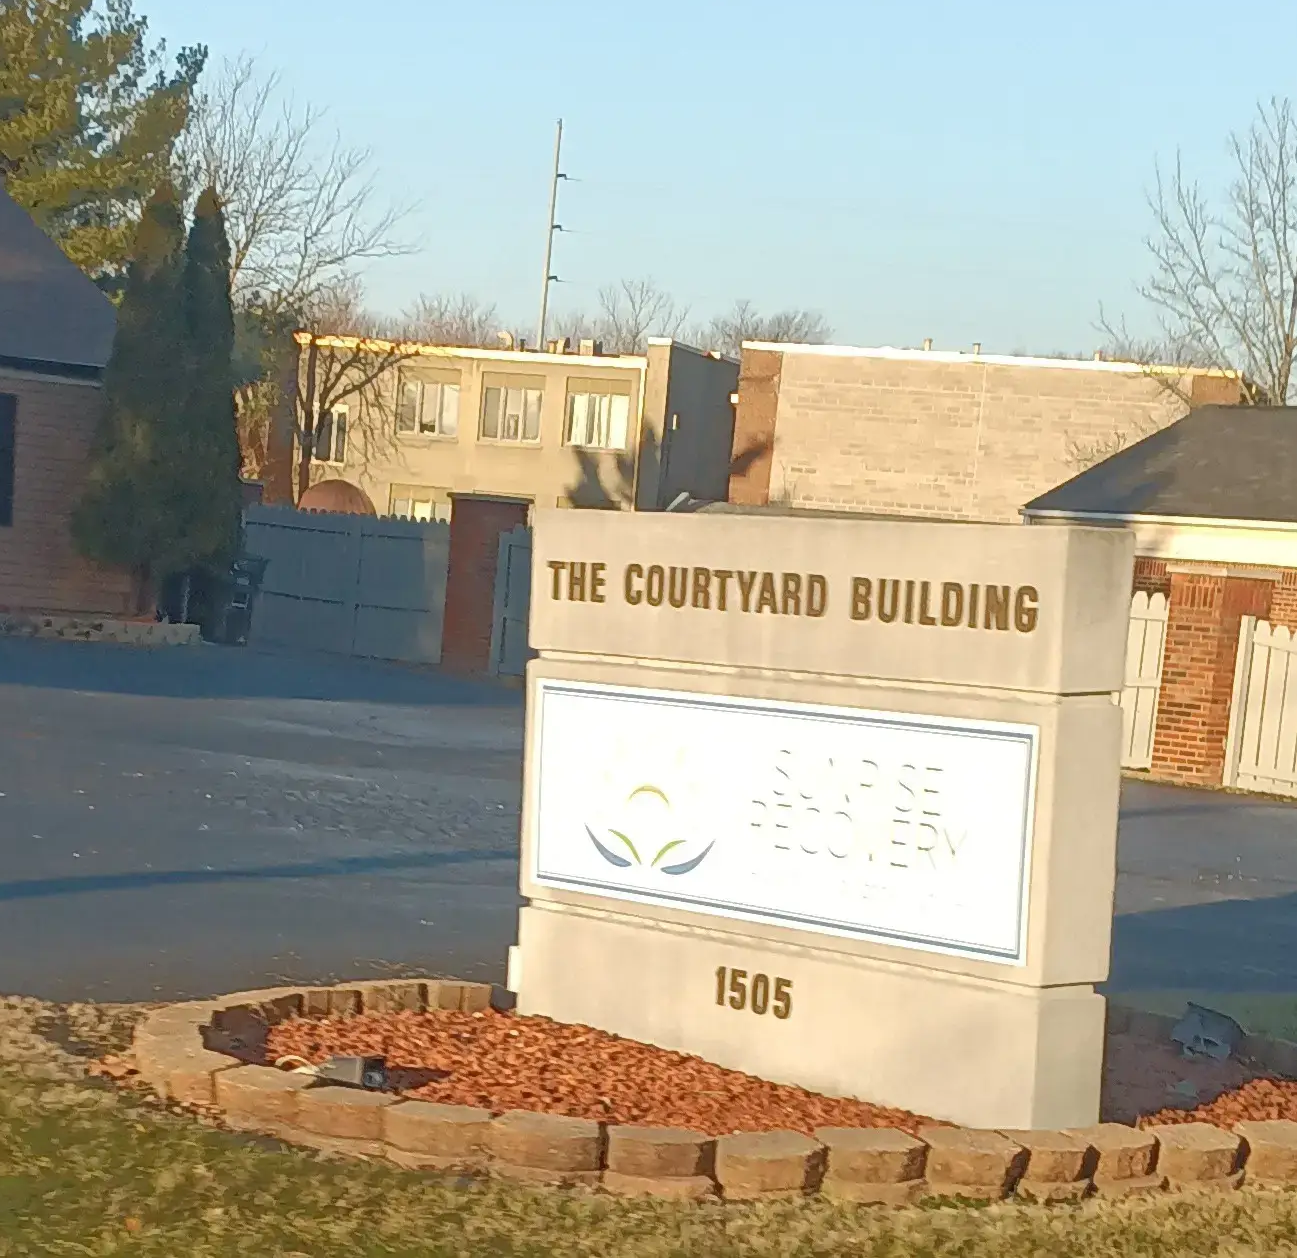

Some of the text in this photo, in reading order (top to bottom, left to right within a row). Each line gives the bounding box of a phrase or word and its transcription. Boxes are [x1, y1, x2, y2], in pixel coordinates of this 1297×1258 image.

[547, 559, 1040, 634] THE COURTYARD BUILDING
[749, 798, 969, 871] RECOERY
[714, 965, 794, 1021] 1505
